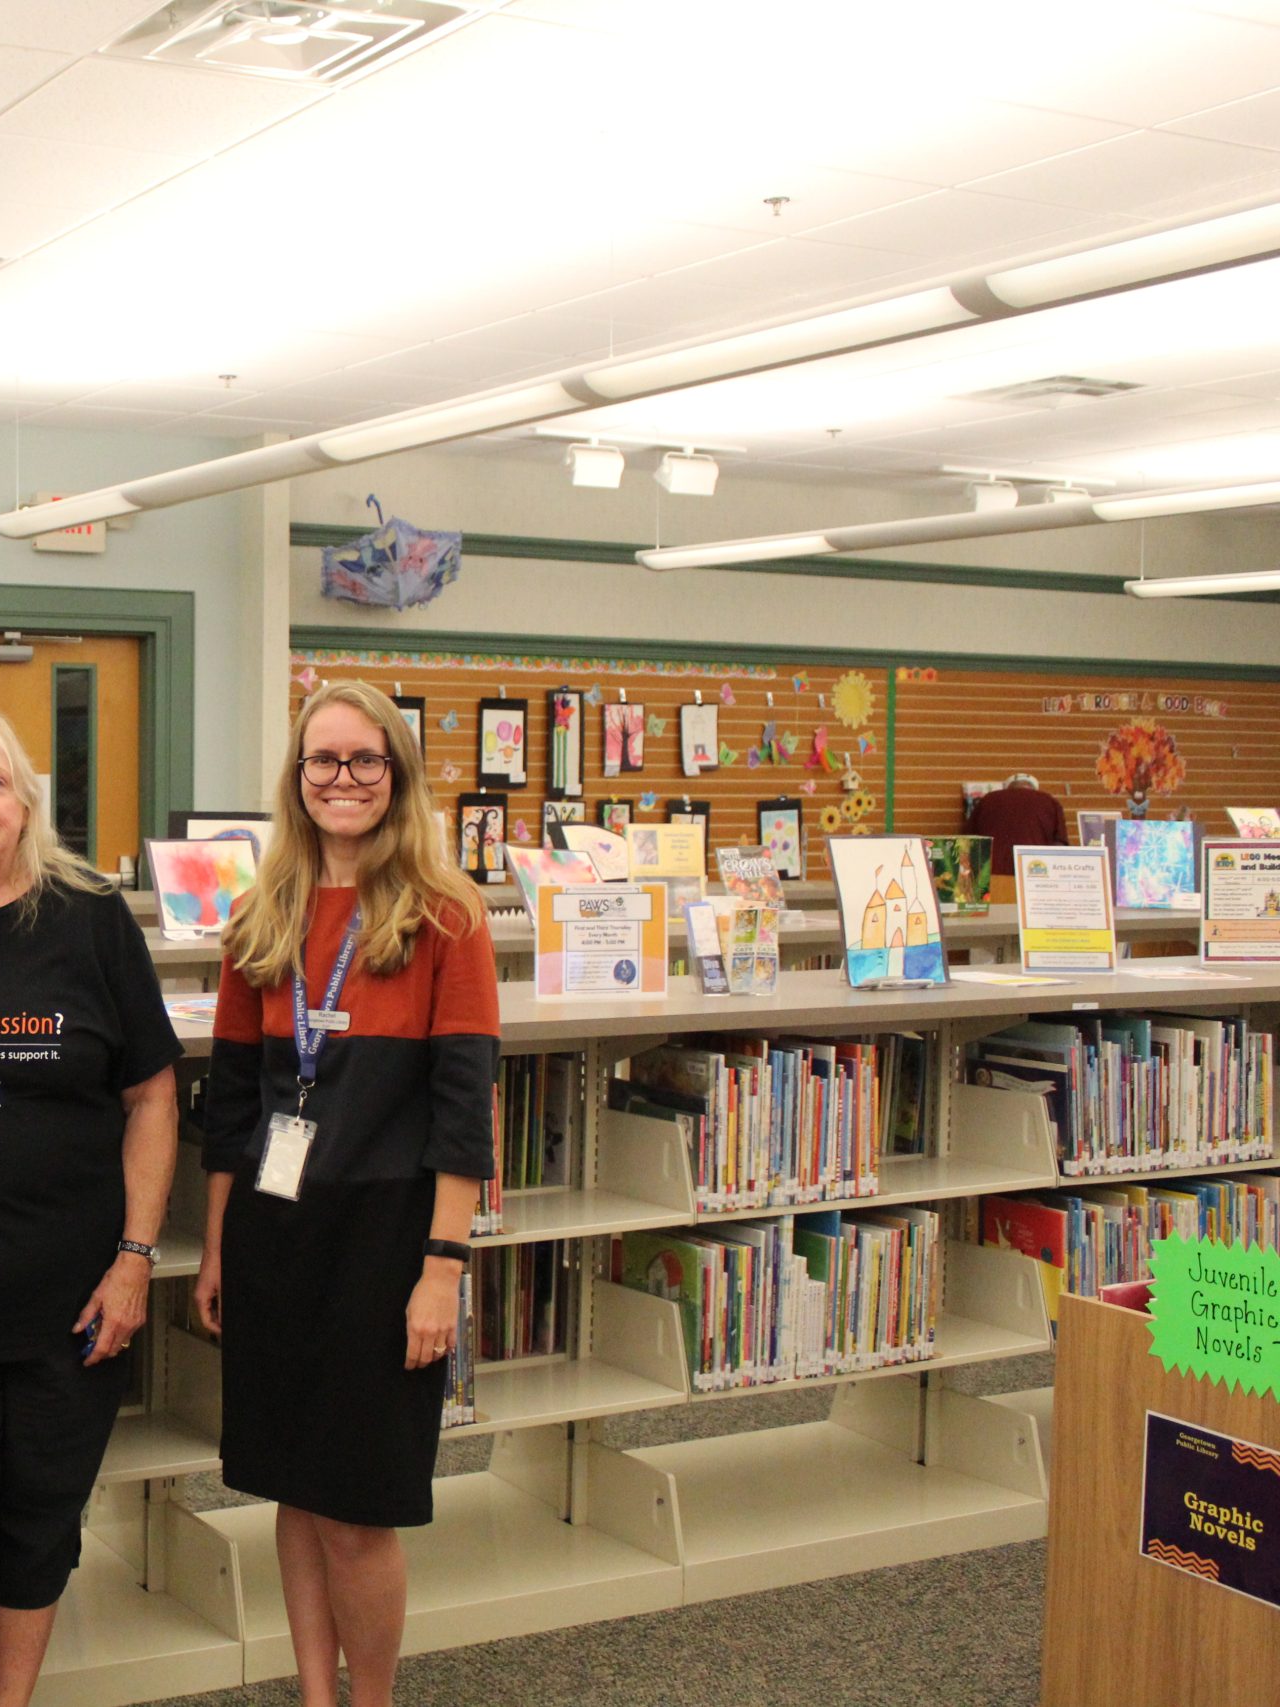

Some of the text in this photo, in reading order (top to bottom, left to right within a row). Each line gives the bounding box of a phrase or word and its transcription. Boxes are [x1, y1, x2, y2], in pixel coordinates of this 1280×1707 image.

[1241, 853, 1261, 861] LEGO
[579, 899, 609, 912] PAWS
[327, 968, 343, 999] Public
[8, 1050, 48, 1061] support
[51, 1050, 61, 1060] it.
[1188, 1252, 1278, 1298] Juvenile
[1191, 1290, 1279, 1334] Graphic
[1196, 1326, 1263, 1363] Novels
[1176, 1438, 1219, 1459] Public Library
[1179, 1432, 1216, 1449] Georgetown
[1183, 1491, 1264, 1533] Graphic
[1189, 1512, 1256, 1551] Novels
